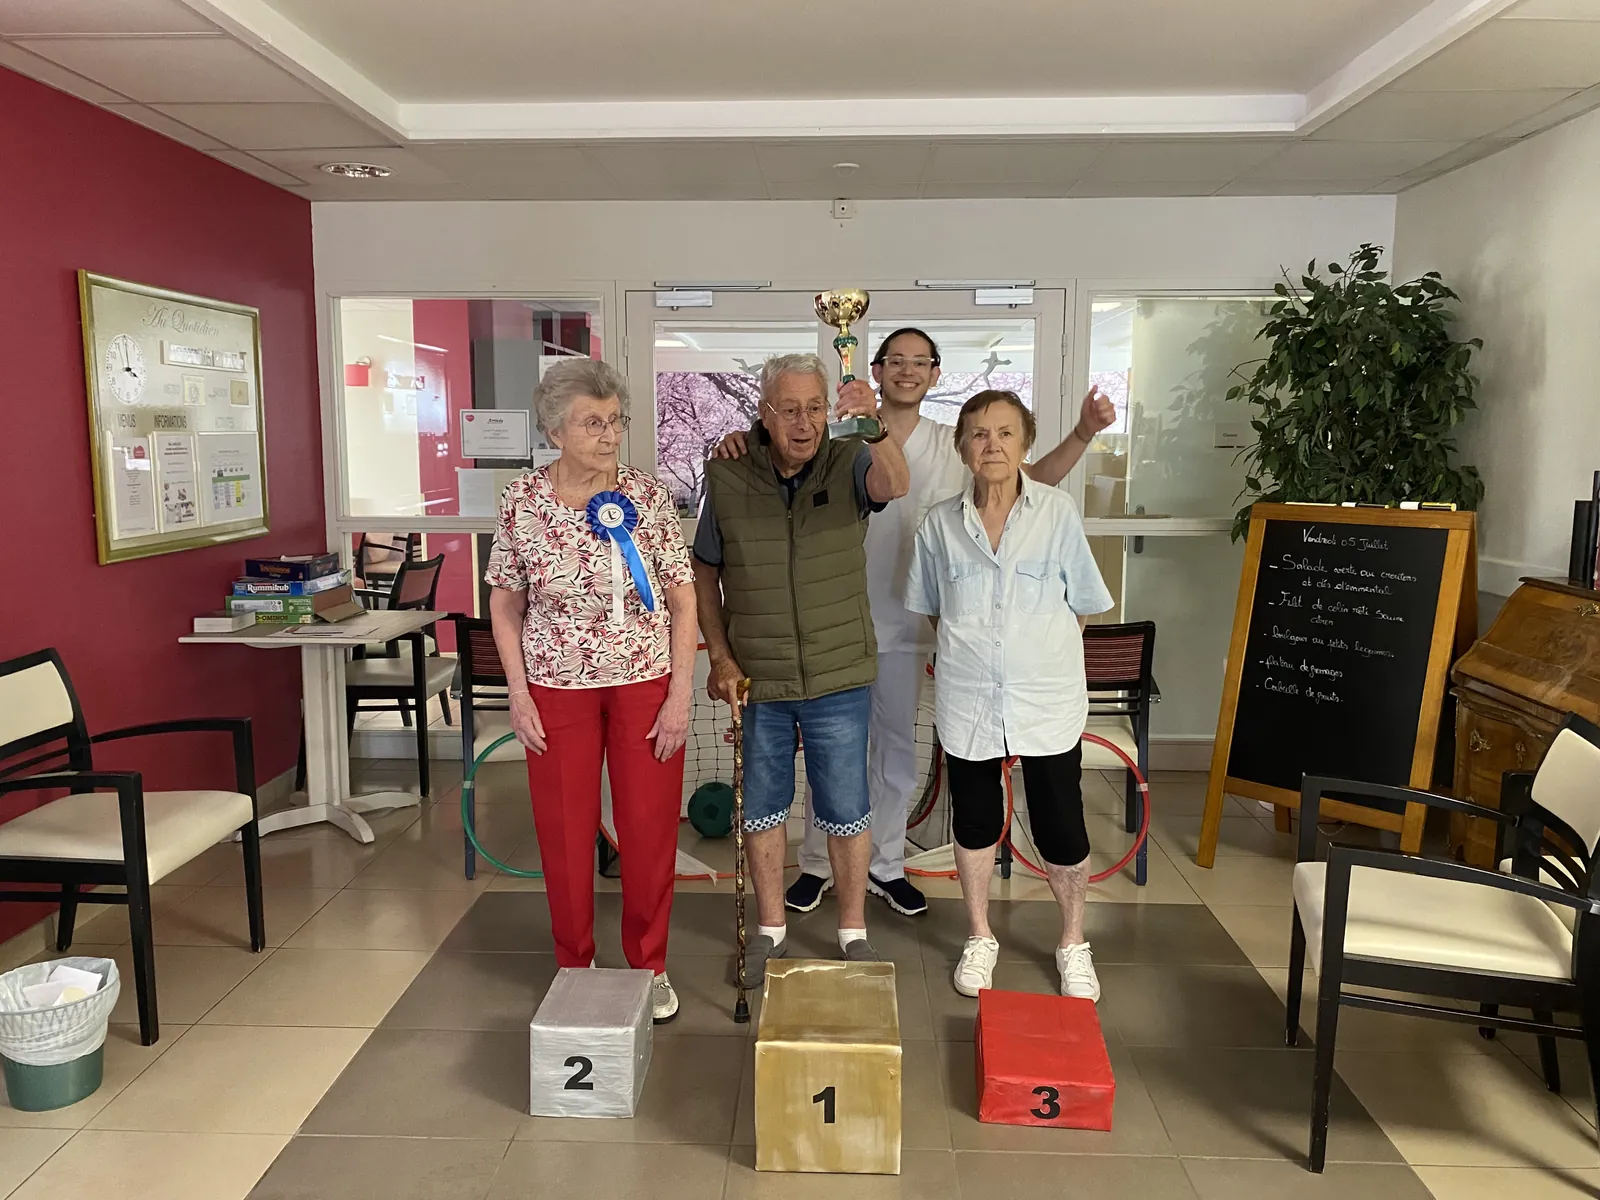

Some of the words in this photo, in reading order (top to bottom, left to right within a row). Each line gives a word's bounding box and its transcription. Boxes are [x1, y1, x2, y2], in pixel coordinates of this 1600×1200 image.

[172, 308, 219, 336] Quotidien
[153, 414, 187, 428] INFORMATIONS
[1341, 537, 1356, 547] 05
[1282, 553, 1328, 573] Salade
[247, 583, 290, 594] Rummikub
[1301, 576, 1312, 587] et
[1312, 598, 1323, 611] de
[563, 1055, 595, 1091] 2
[812, 1086, 837, 1124] 1
[1030, 1085, 1061, 1119] 3
